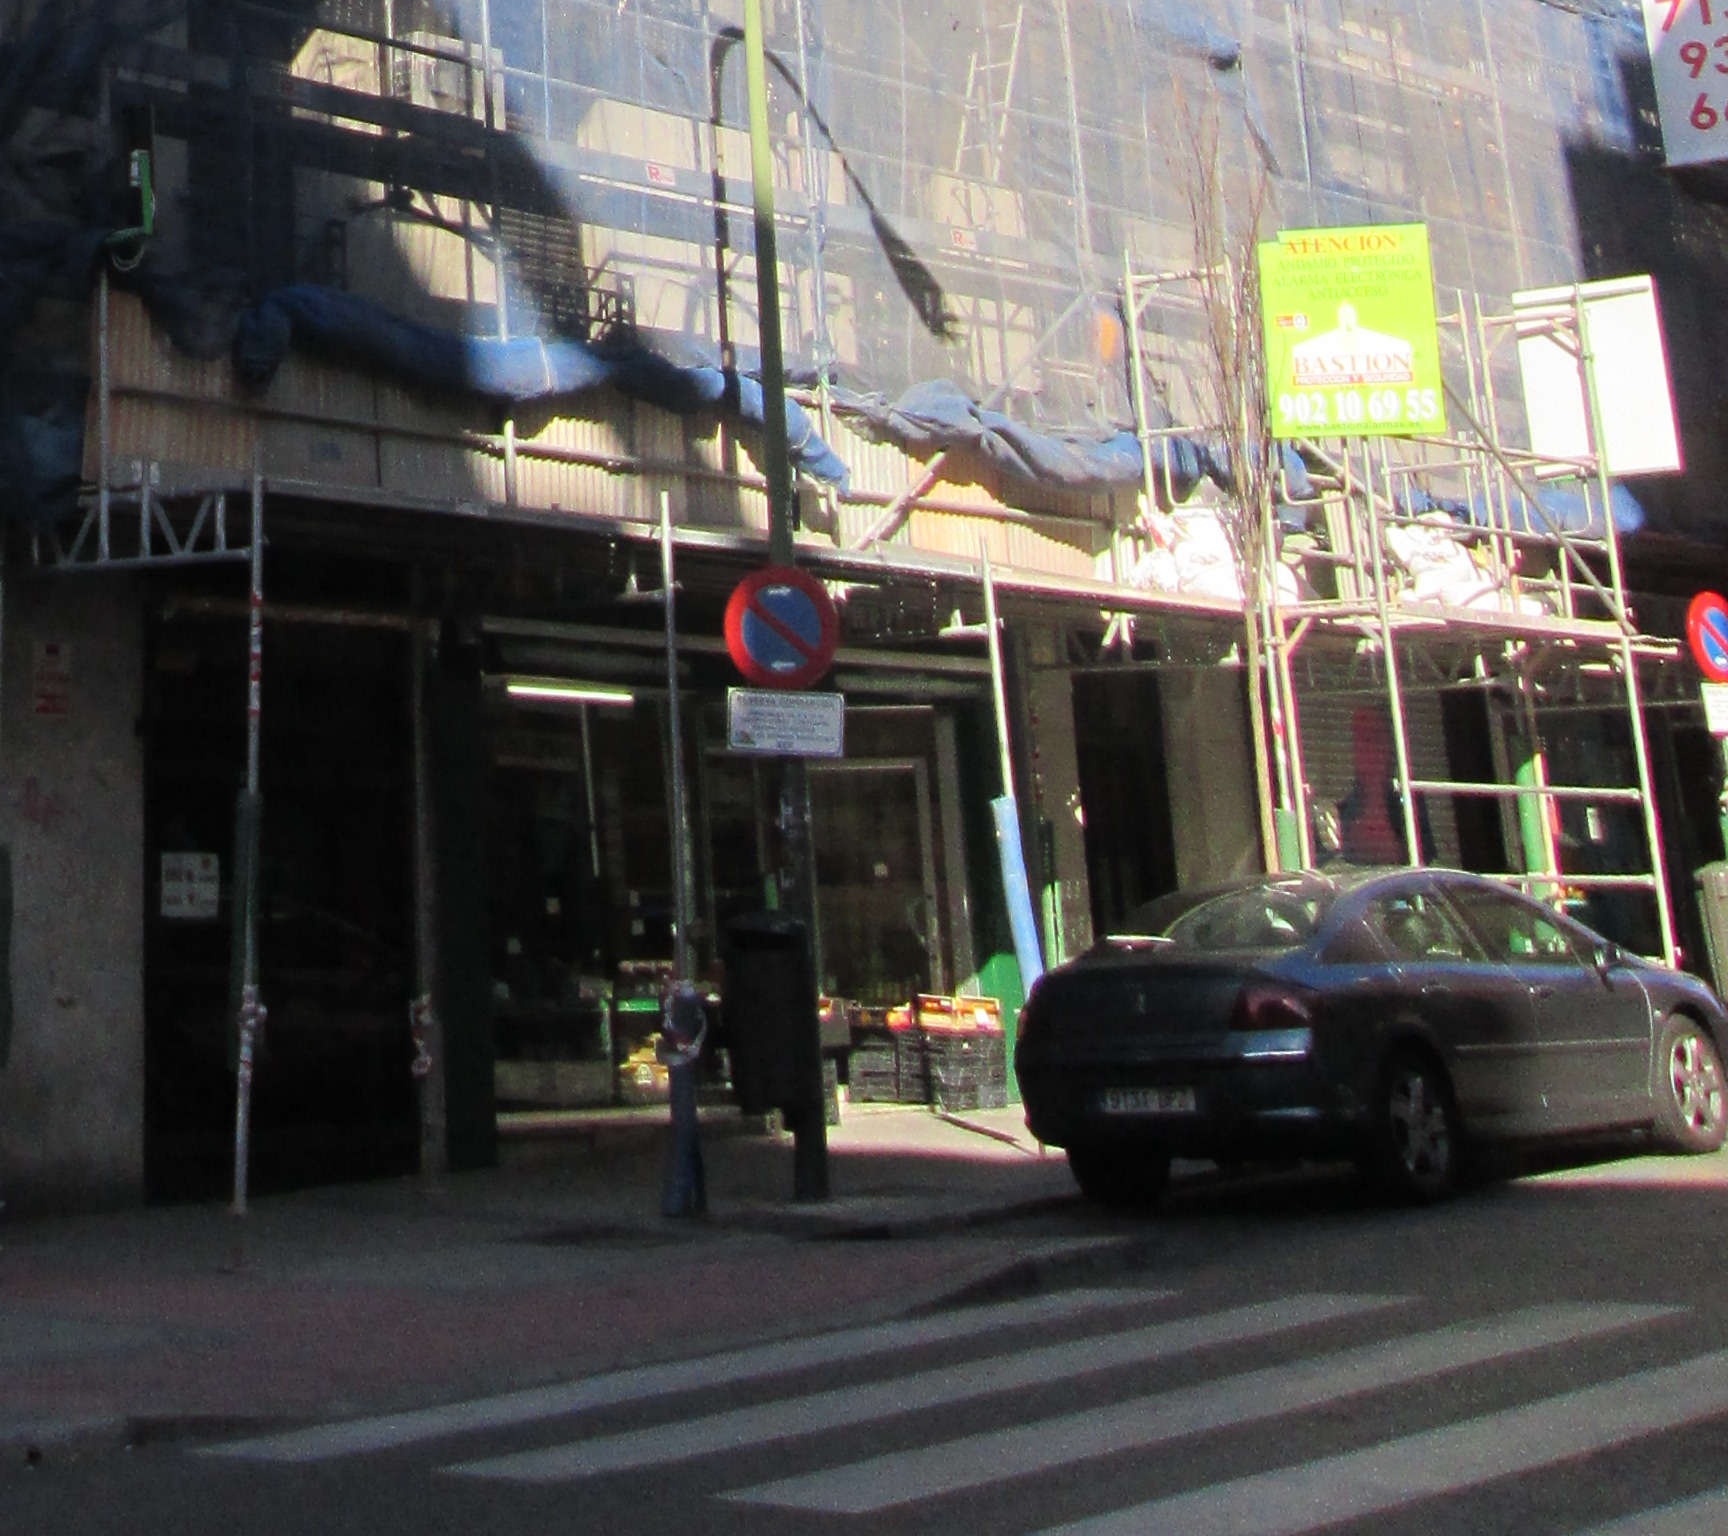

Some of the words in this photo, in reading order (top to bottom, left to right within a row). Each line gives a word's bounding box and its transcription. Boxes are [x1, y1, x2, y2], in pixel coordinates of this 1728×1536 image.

[1690, 92, 1728, 131] 6
[1284, 230, 1397, 255] ATENCIÓN
[1277, 257, 1338, 272] ANDAMIO
[1343, 253, 1415, 267] PROTEGIDO
[1273, 274, 1329, 288] ALARMA
[1335, 268, 1422, 284] ELECTRÓNICA
[1308, 285, 1388, 300] ANTIACCESO
[1294, 352, 1412, 374] BASTION
[1279, 392, 1327, 423] 902
[1334, 390, 1364, 421] 10
[1368, 388, 1400, 420] 69
[1406, 387, 1438, 420] 55
